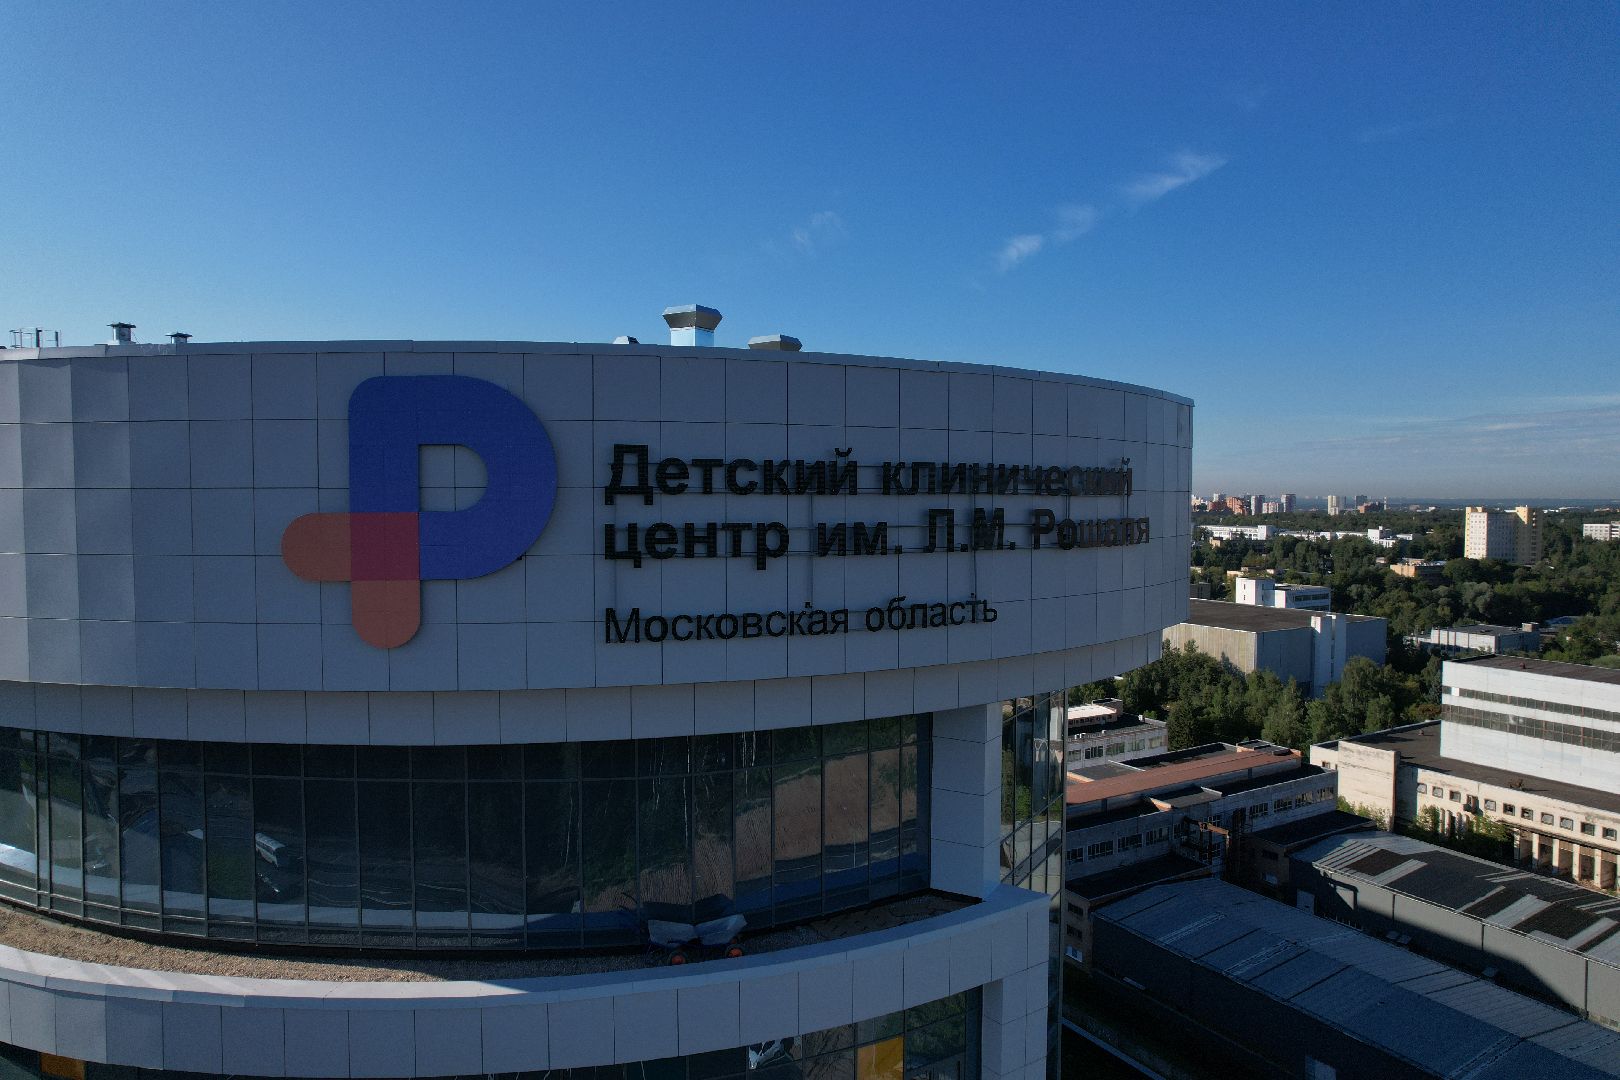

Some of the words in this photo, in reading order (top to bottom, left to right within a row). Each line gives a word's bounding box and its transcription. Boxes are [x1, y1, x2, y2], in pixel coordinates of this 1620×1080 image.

[604, 444, 858, 505] Детский
[604, 521, 790, 571] центр
[817, 521, 903, 557] им.
[1031, 508, 1150, 551] Рошаля
[605, 607, 849, 644] Московская
[865, 596, 998, 632] область
